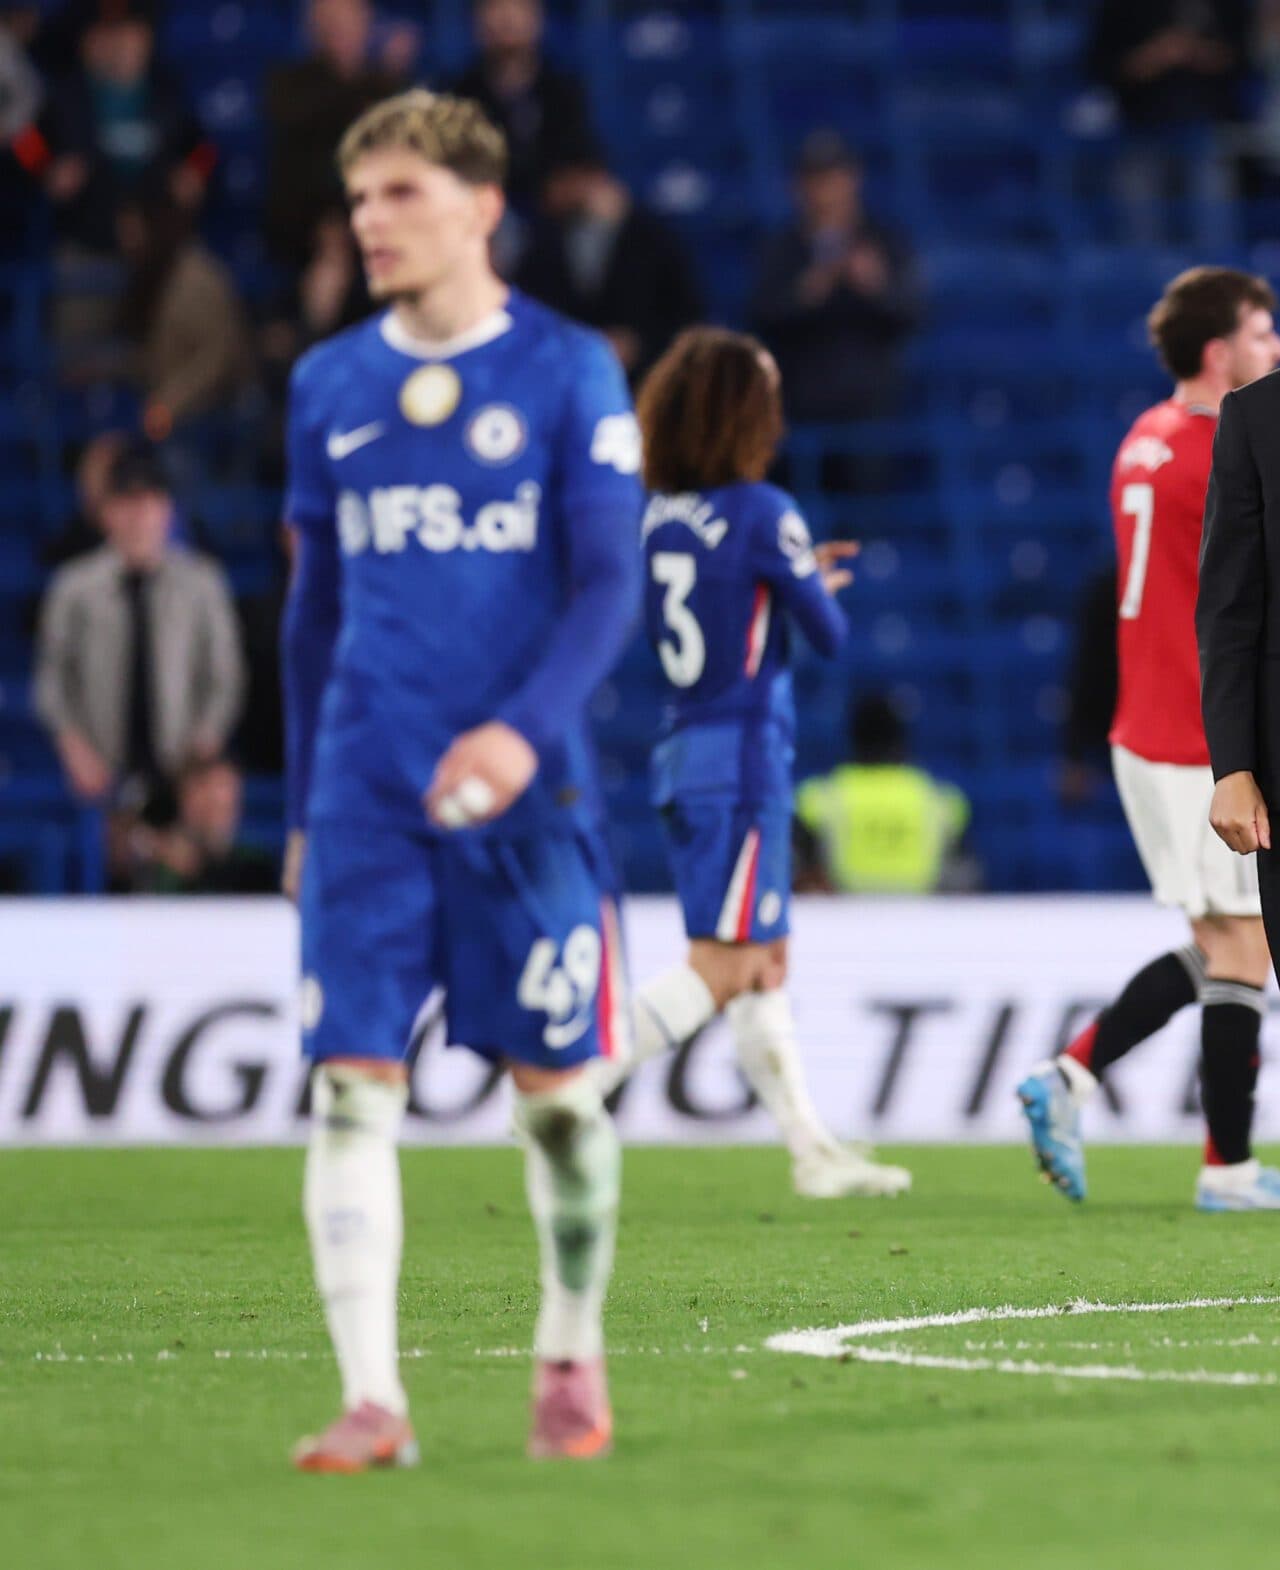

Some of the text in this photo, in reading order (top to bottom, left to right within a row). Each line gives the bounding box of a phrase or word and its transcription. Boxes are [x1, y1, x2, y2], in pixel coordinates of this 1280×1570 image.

[368, 478, 544, 554] IFS.ai
[1120, 482, 1155, 620] 7
[651, 550, 706, 688] 3
[516, 922, 600, 1022] 49
